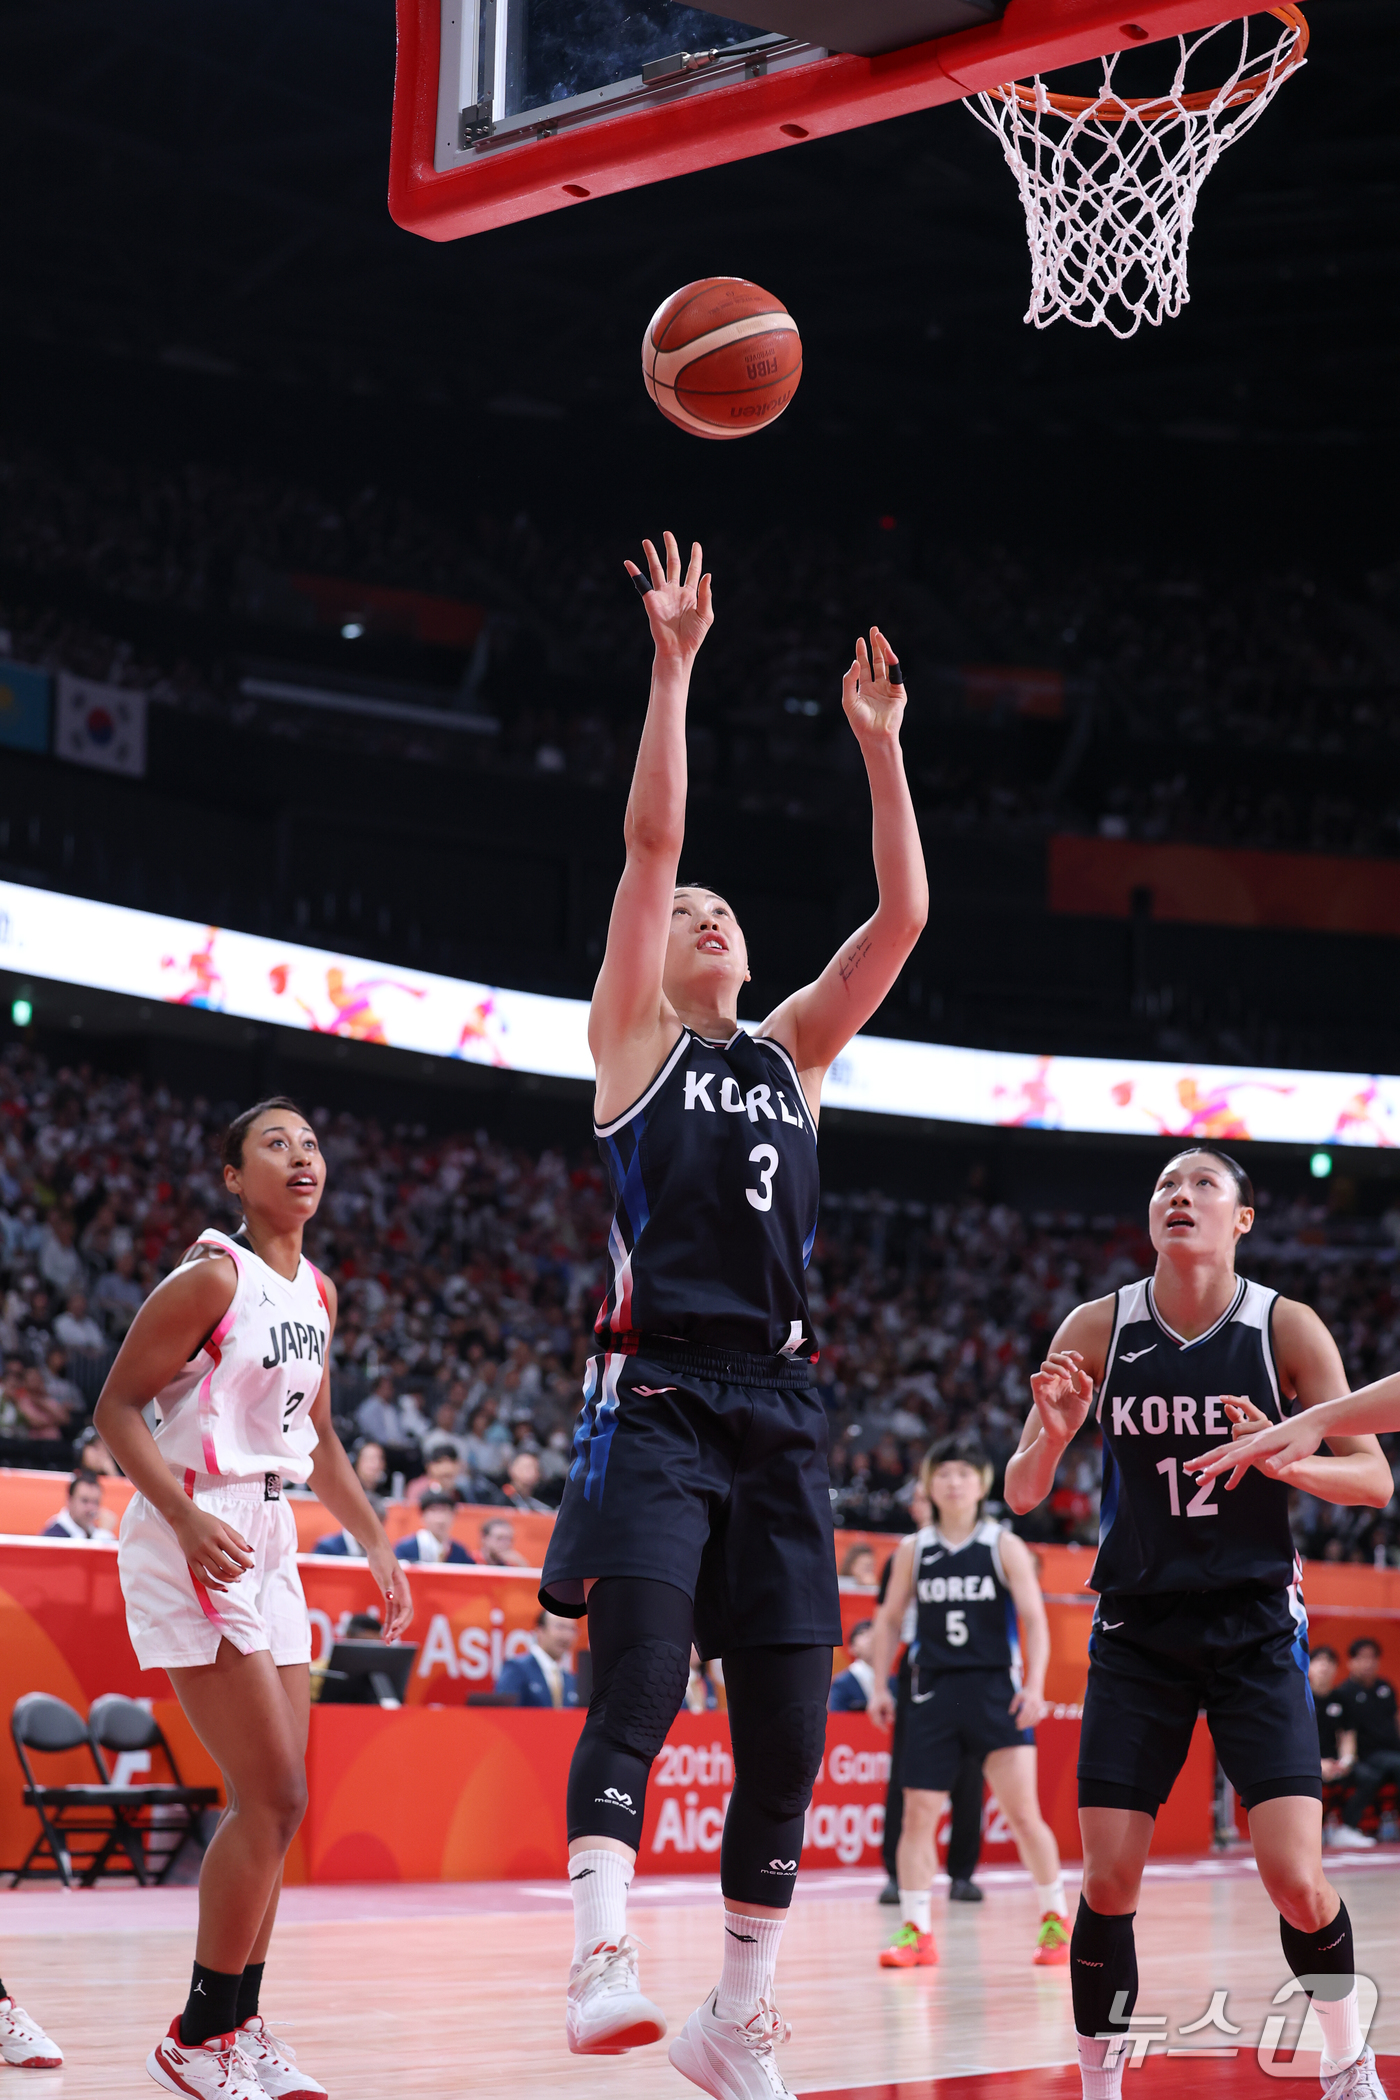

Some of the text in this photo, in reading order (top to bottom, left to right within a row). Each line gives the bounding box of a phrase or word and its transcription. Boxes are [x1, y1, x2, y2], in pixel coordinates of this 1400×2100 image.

[746, 357, 778, 380] FIBA
[730, 390, 791, 418] molten
[745, 1143, 779, 1212] 3
[1112, 1395, 1250, 1436] KORE
[1155, 1457, 1219, 1518] 12
[917, 1575, 996, 1603] KOREA
[945, 1609, 969, 1647] 5
[654, 1740, 735, 1787] 20th
